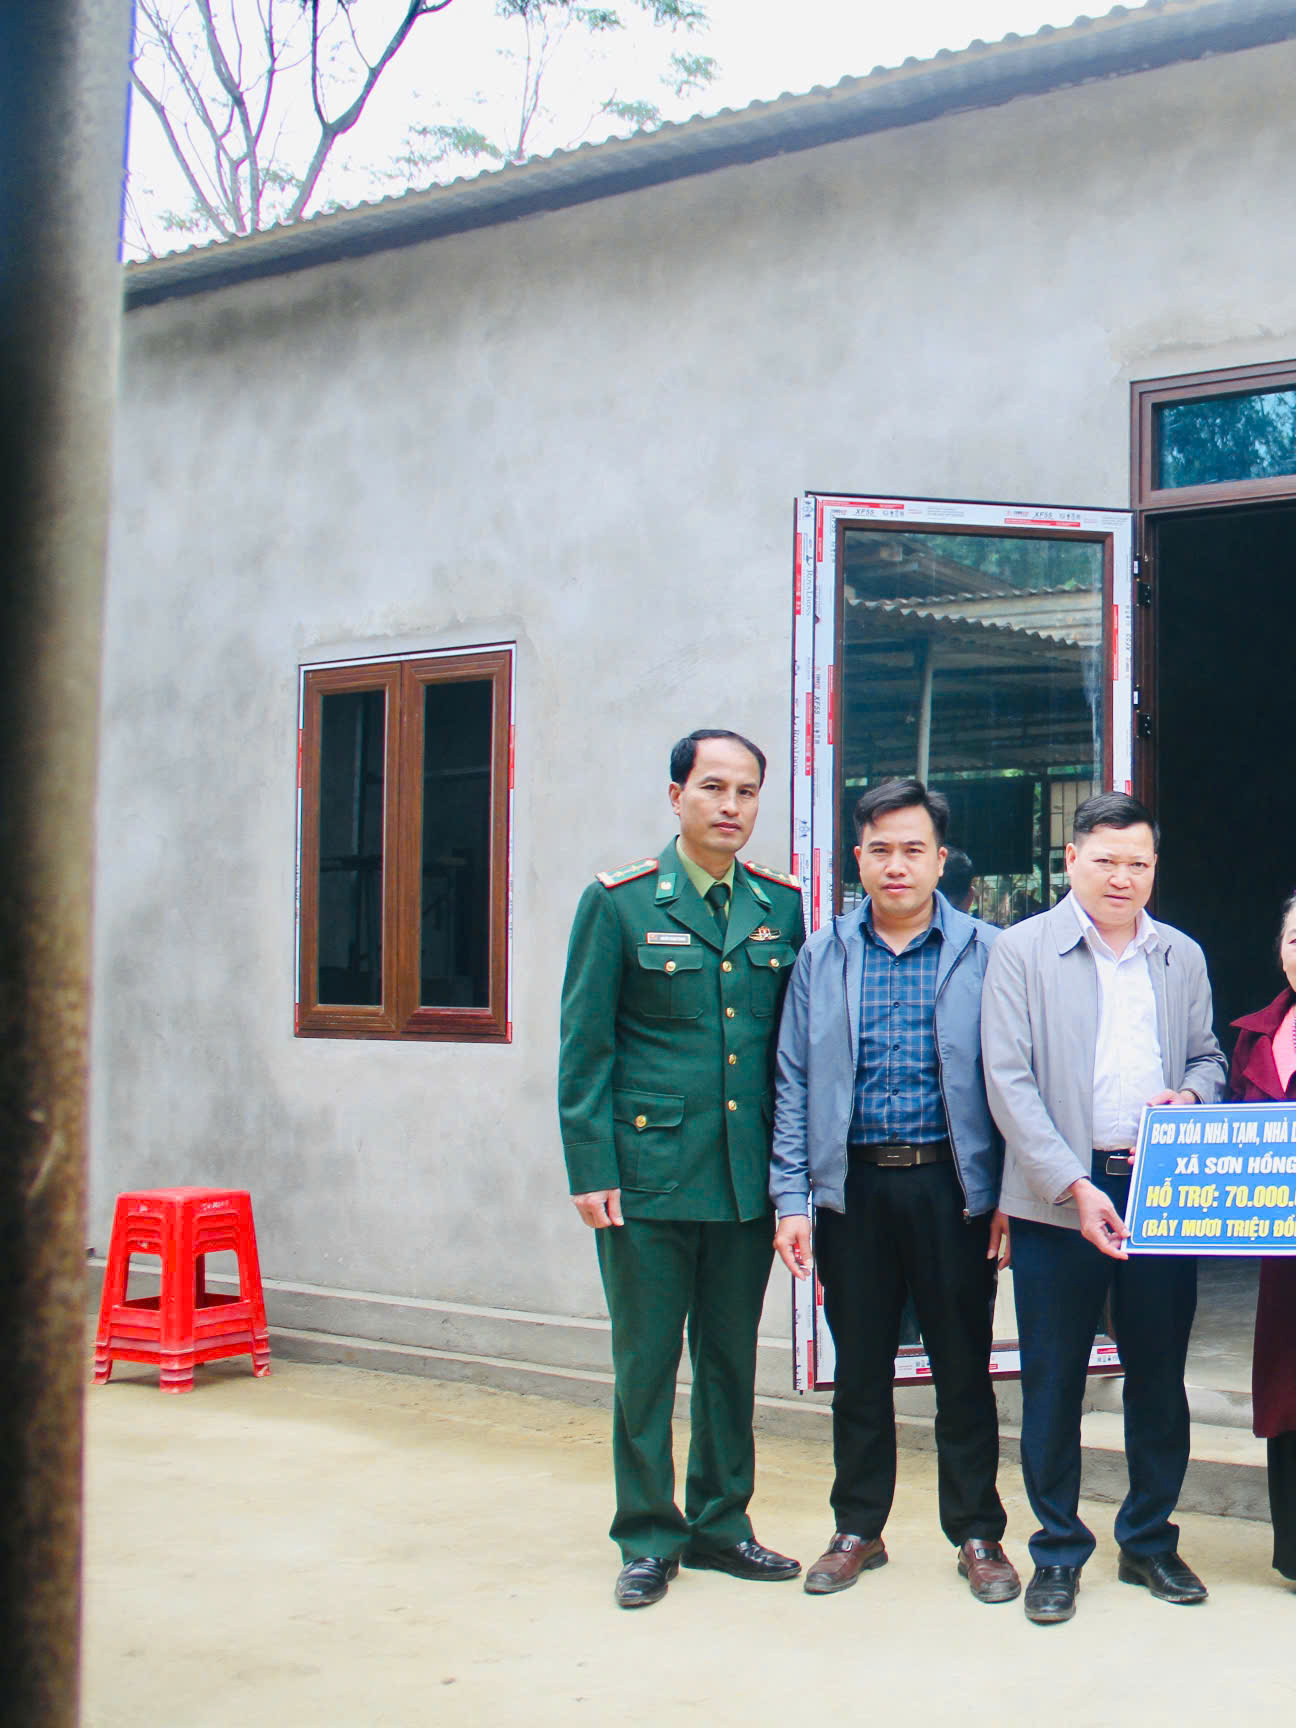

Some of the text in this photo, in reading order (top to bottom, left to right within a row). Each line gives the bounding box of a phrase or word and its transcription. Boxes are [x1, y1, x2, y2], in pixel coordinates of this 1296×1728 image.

[1177, 1118, 1202, 1144] XÓA
[1231, 1121, 1260, 1148] TẠM,
[1174, 1154, 1200, 1174] XÃ
[1204, 1155, 1243, 1174] SƠN
[1145, 1177, 1172, 1207] HỖ
[1178, 1184, 1219, 1212] TRỢ:
[1142, 1212, 1179, 1239] (BẢY
[1226, 1216, 1270, 1241] TRIỆU
